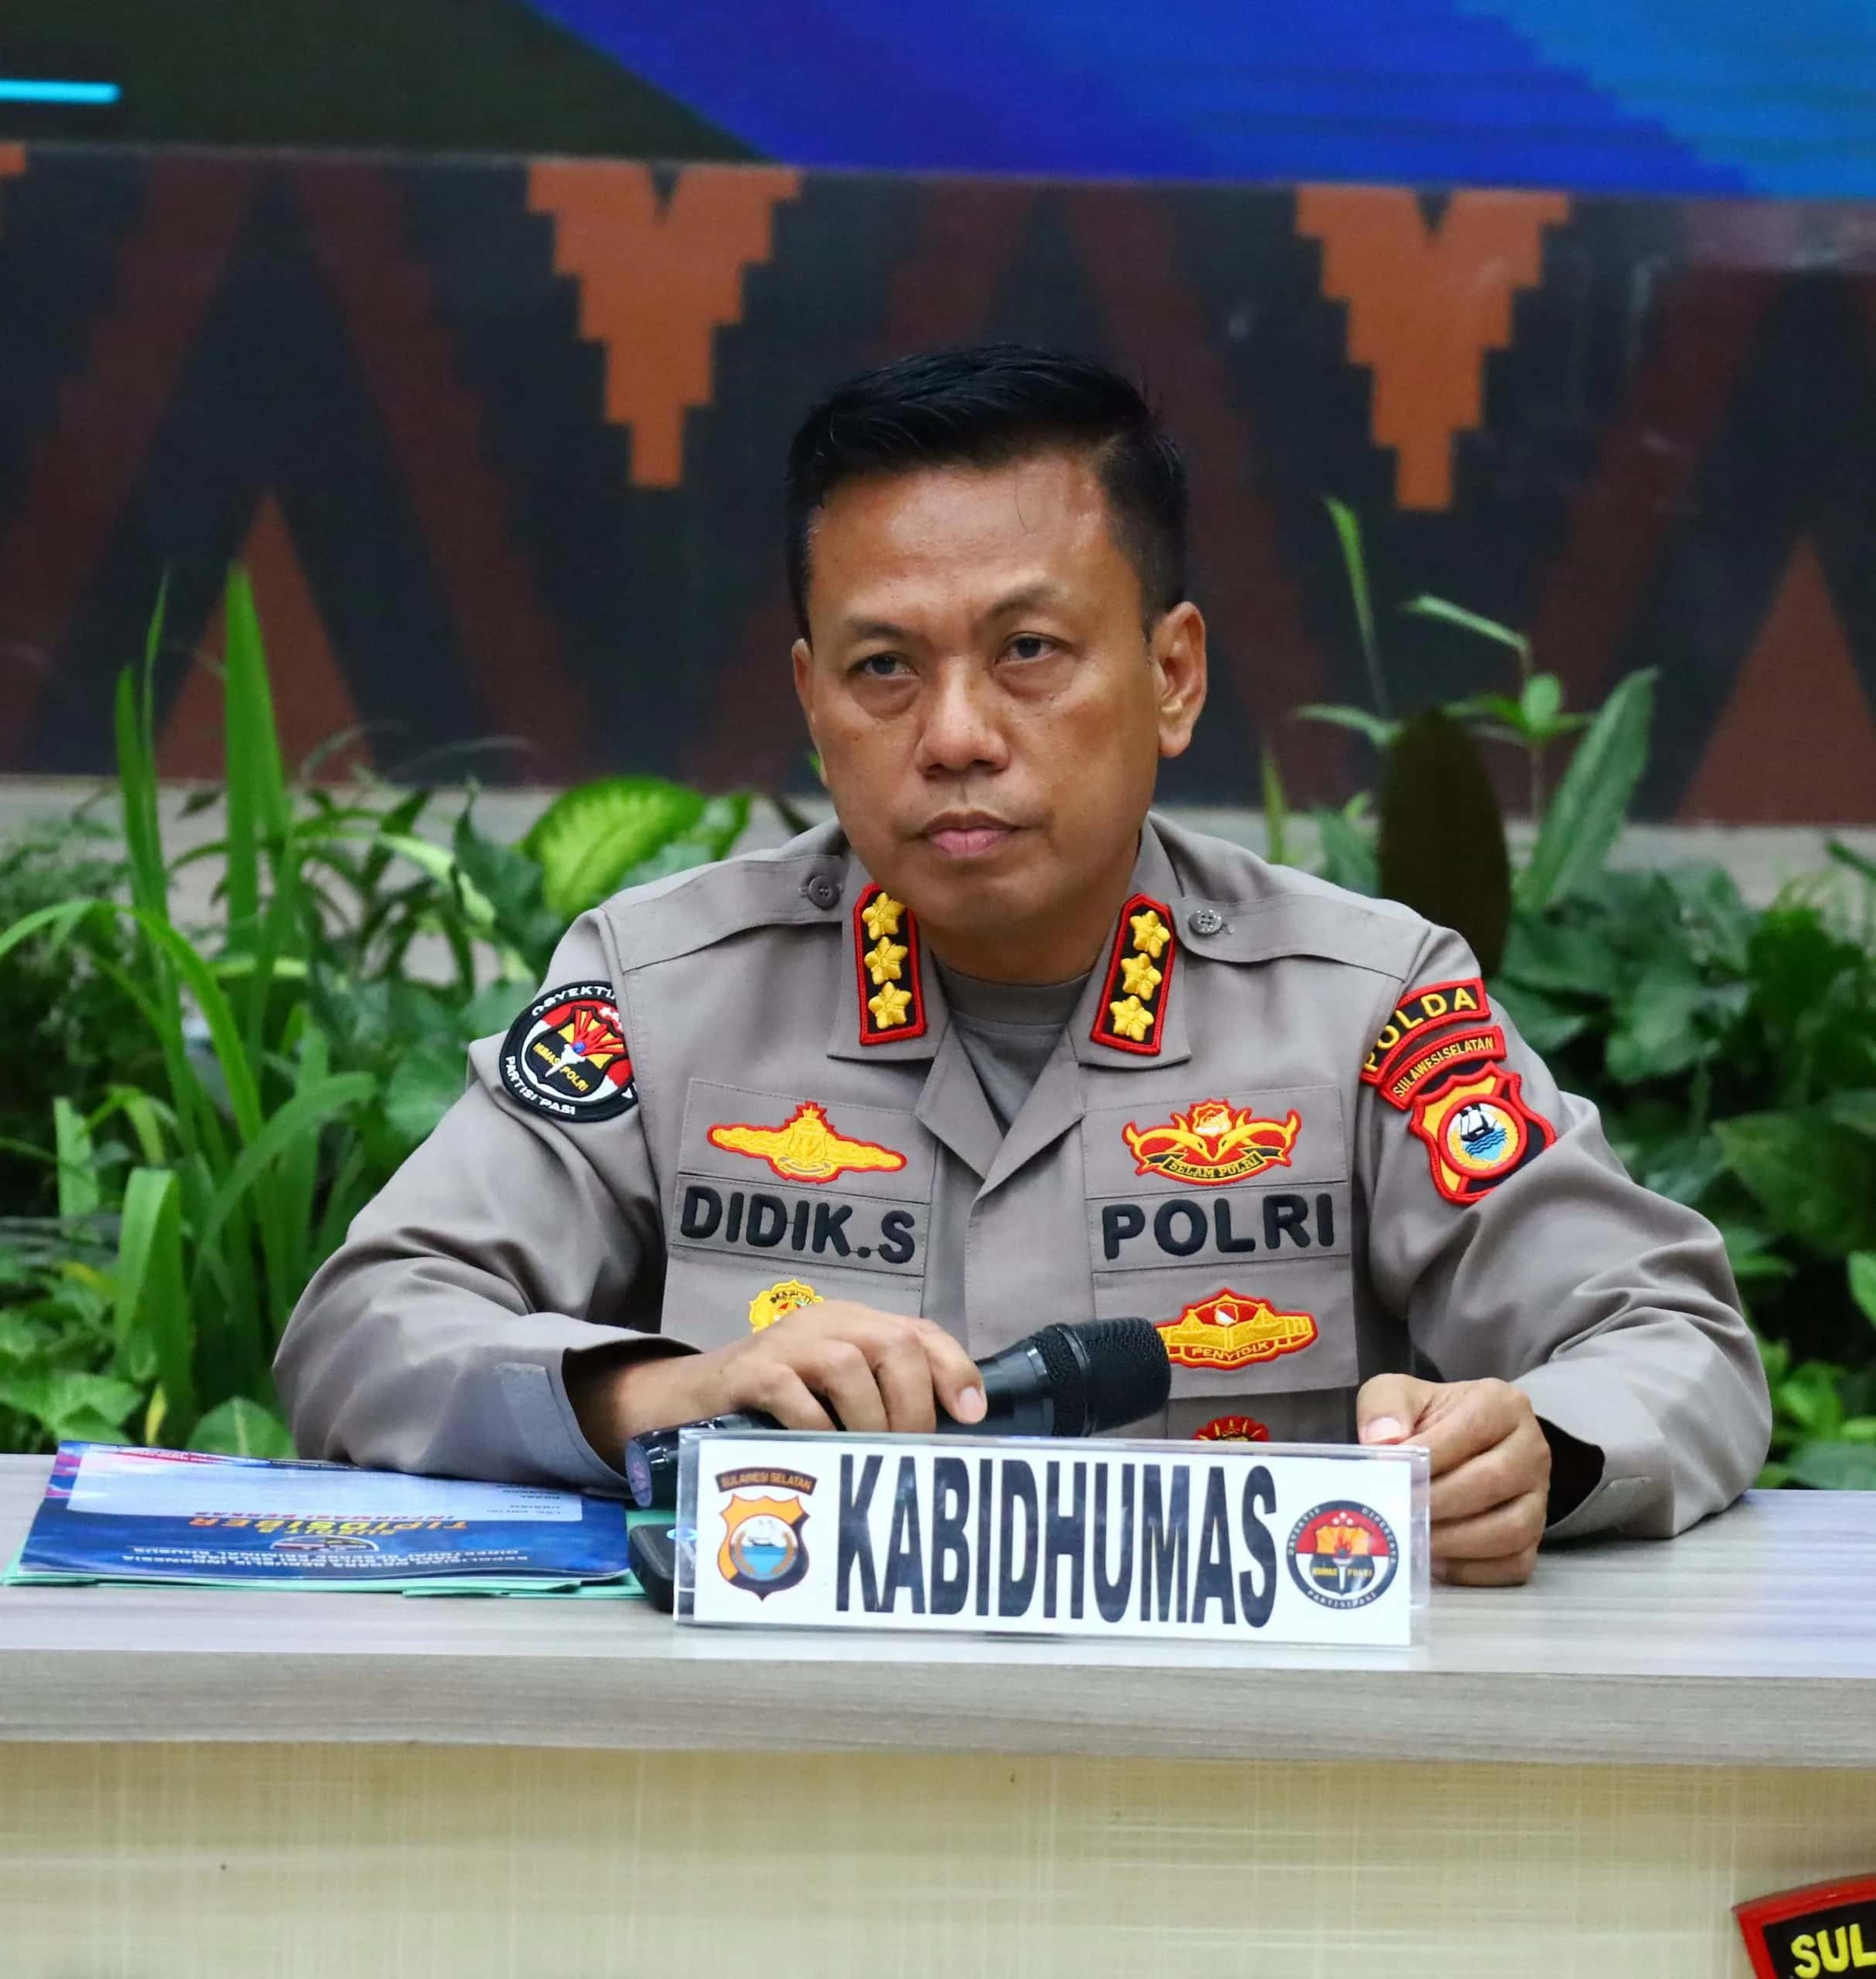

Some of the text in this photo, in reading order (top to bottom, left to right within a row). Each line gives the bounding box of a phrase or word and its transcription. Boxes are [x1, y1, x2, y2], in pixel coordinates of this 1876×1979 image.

[1364, 986, 1479, 1073] POLDA
[1219, 1156, 1261, 1176] POLRI
[680, 1185, 915, 1264] DIDIK.S
[1101, 1193, 1335, 1262] POLRI
[1191, 1341, 1269, 1361] PENYIDIK
[836, 1453, 1277, 1628] KABIDHUMAS
[1790, 1923, 1876, 1979] SUL
